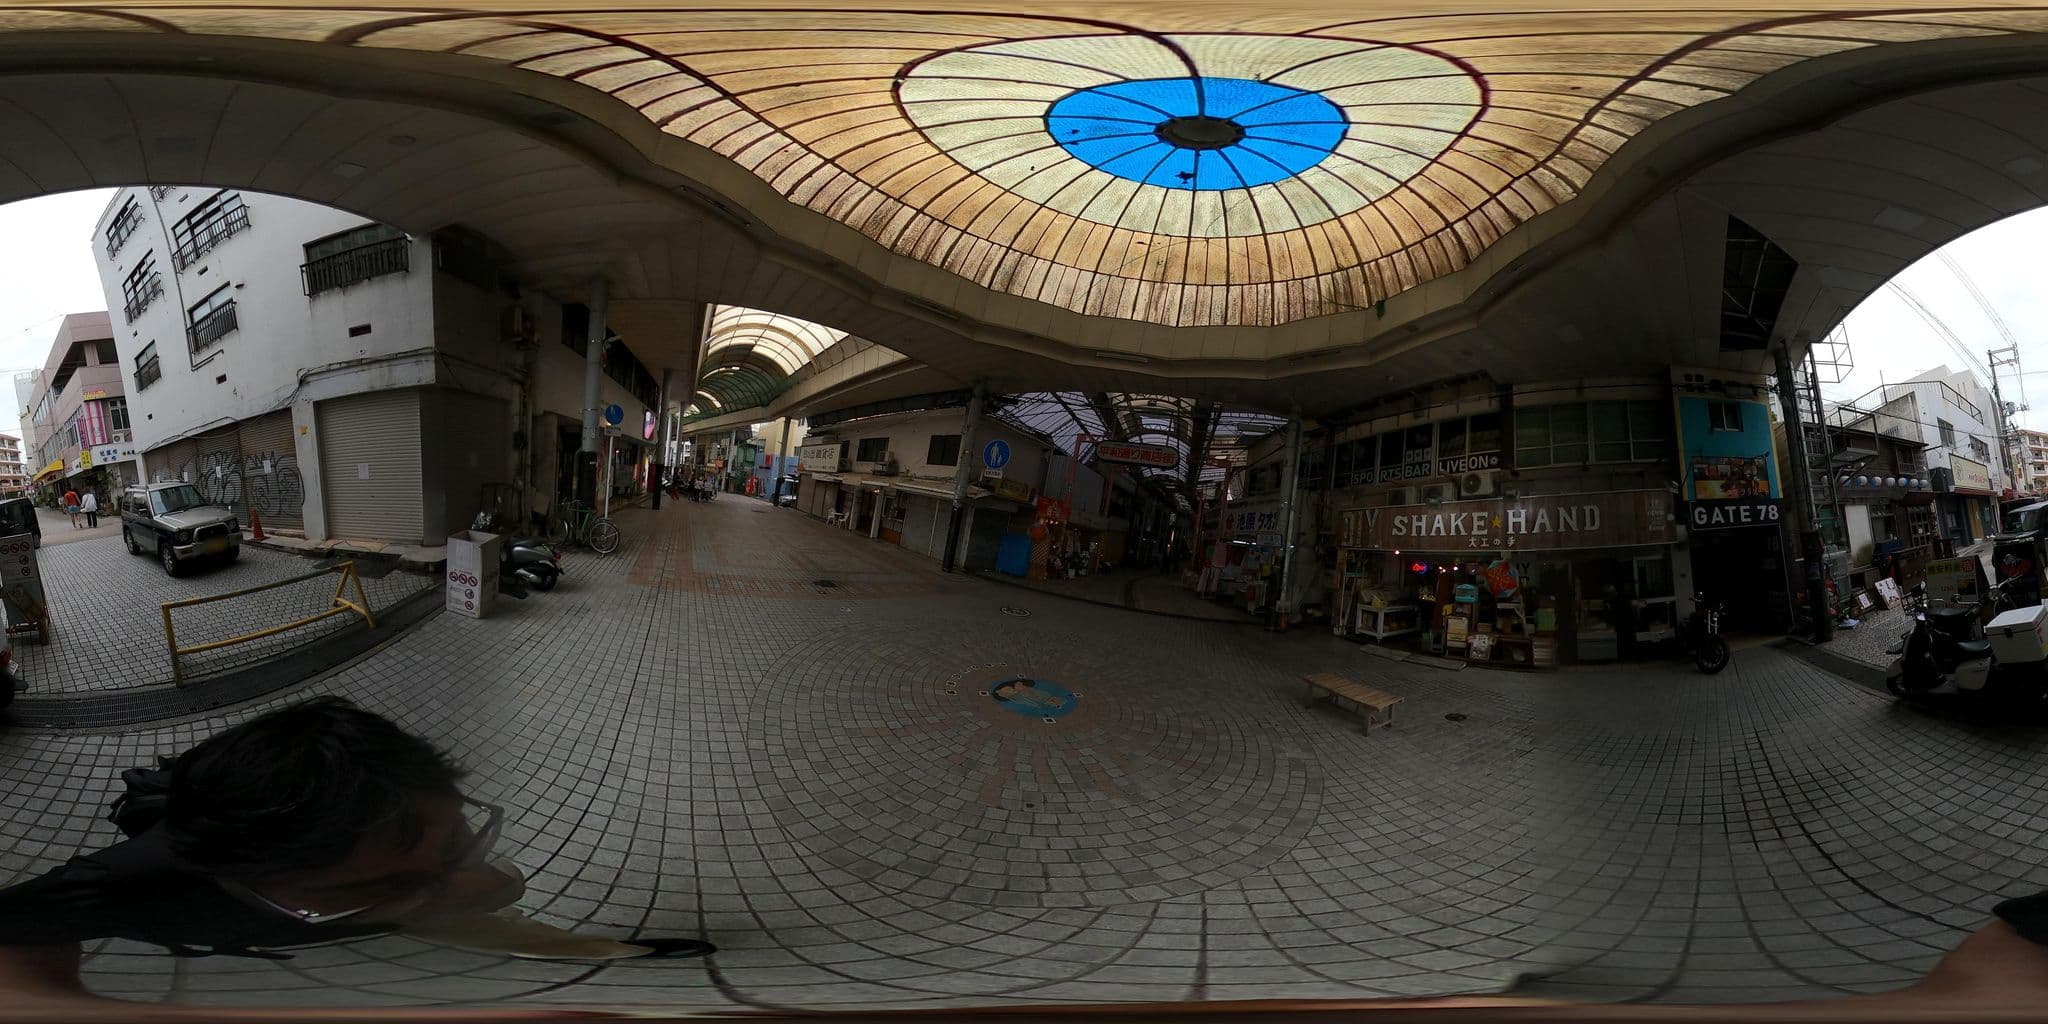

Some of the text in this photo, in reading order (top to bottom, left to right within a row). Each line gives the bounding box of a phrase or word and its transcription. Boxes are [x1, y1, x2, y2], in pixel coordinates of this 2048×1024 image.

[1404, 462, 1431, 478] BAR
[1438, 454, 1489, 473] LIVE ON
[1392, 511, 1489, 537] SHAKE
[1506, 504, 1601, 535] HAND
[1694, 503, 1780, 525] GATE 78
[1468, 536, 1517, 549] 大工の手
